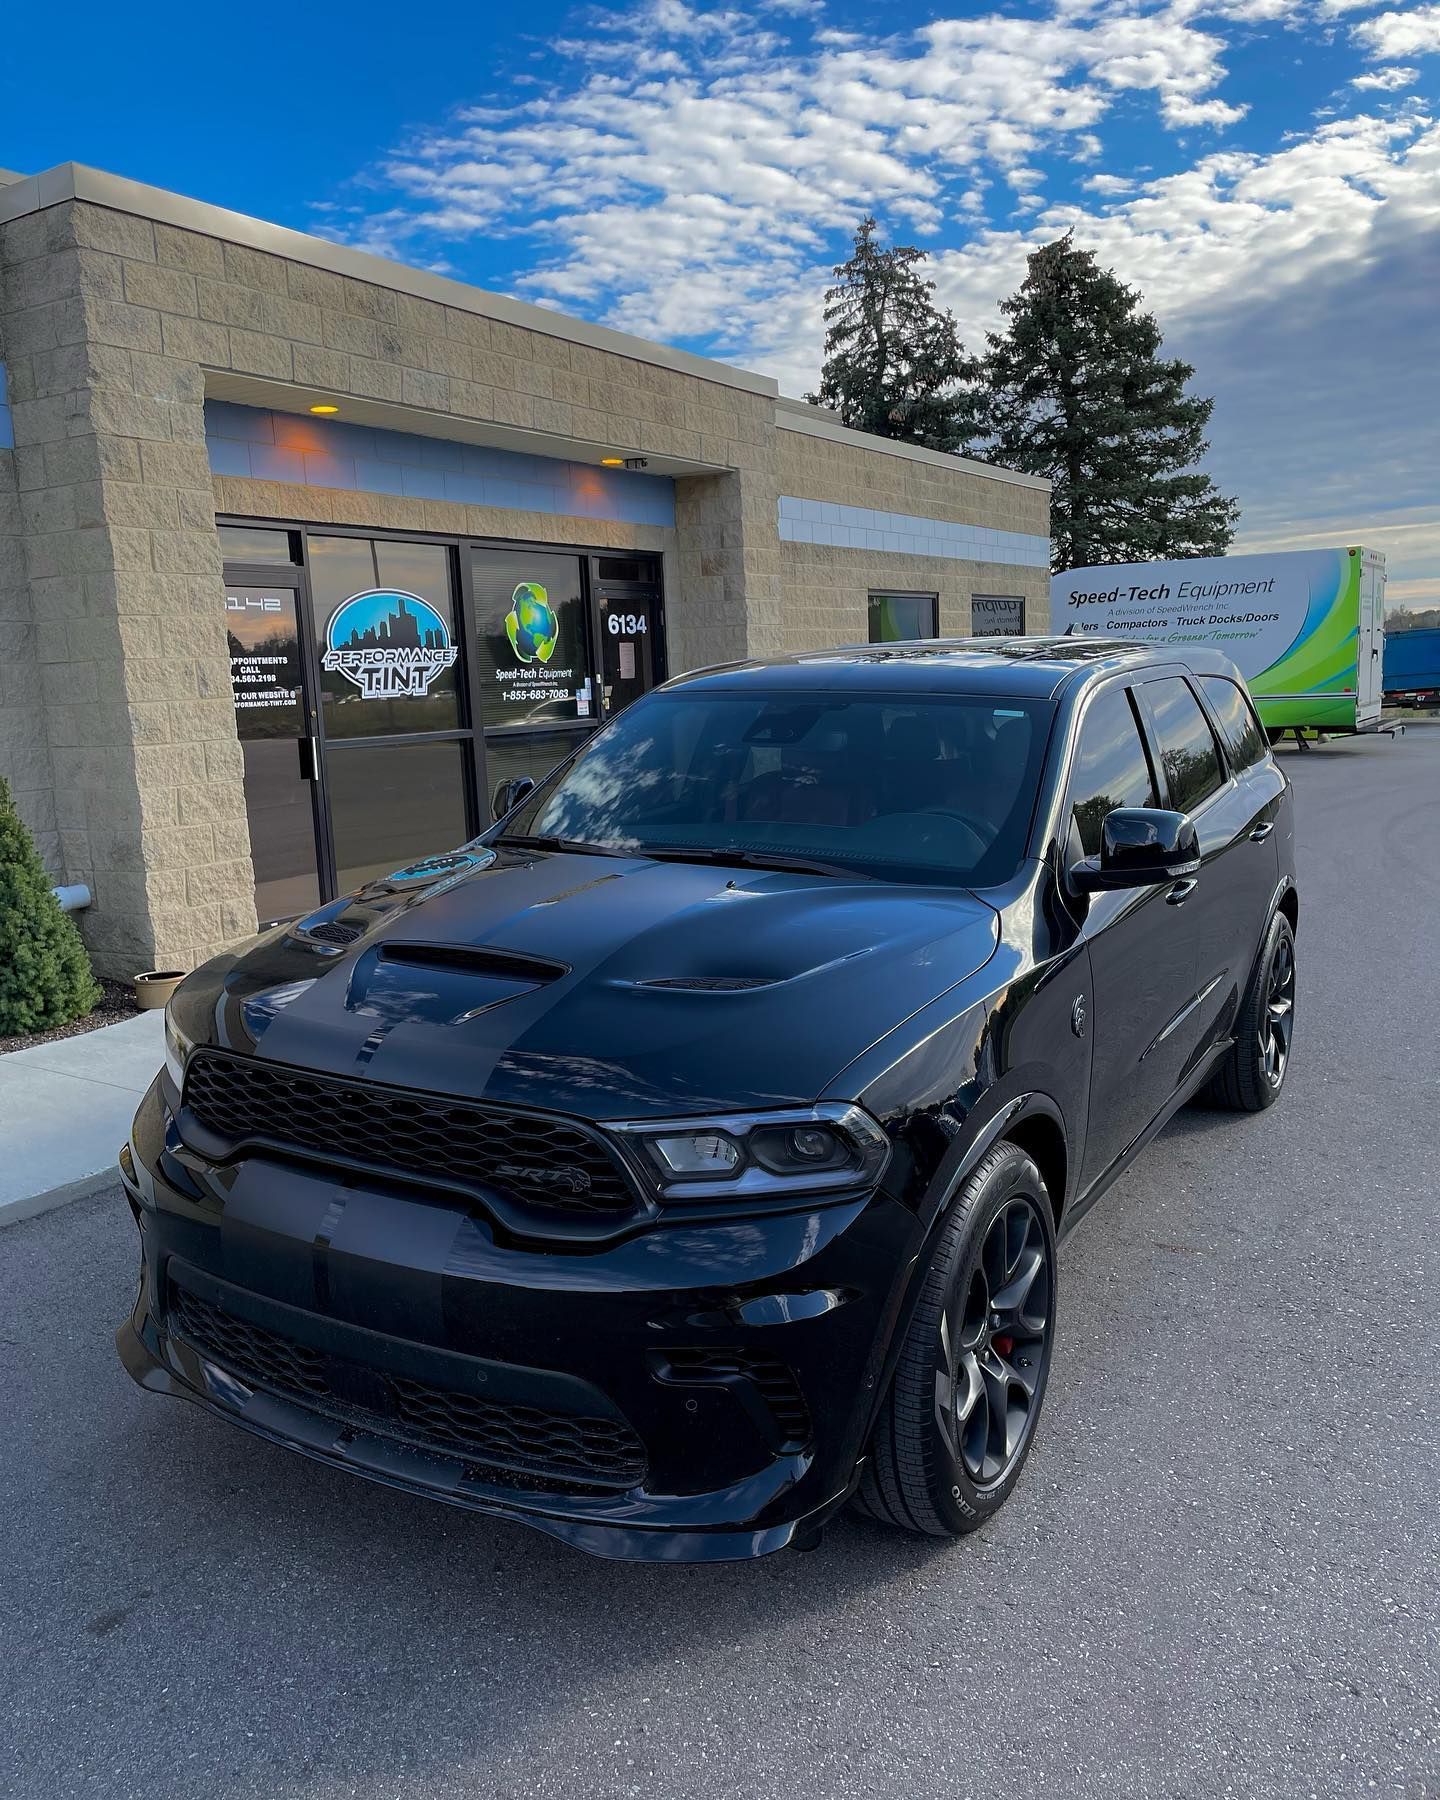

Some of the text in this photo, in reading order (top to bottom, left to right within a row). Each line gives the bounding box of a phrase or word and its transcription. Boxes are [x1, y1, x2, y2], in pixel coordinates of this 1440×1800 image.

[1068, 578, 1276, 609] Speed-Tech Equipment
[224, 597, 281, 611] 142
[1115, 607, 1145, 616] division
[1147, 606, 1156, 614] of
[607, 613, 648, 635] 6134
[1106, 619, 1168, 630] Compactors
[1176, 615, 1206, 626] Truck
[1208, 613, 1280, 625] Docks/Doors
[1167, 631, 1208, 643] Greener
[326, 648, 455, 668] PERFORMANCE
[240, 665, 261, 674] CALL
[495, 667, 573, 682] Speed-Tech Equipment
[230, 674, 277, 684] 34.560.2198
[357, 664, 437, 696] TINT
[241, 691, 258, 701] OUR
[258, 690, 290, 700] WEBSITE
[502, 688, 570, 701] 1-855-683-7063
[234, 699, 297, 709] RFORMANCE-TINT.COM
[495, 1165, 562, 1183] SRT
[951, 1485, 977, 1520] ZERO
